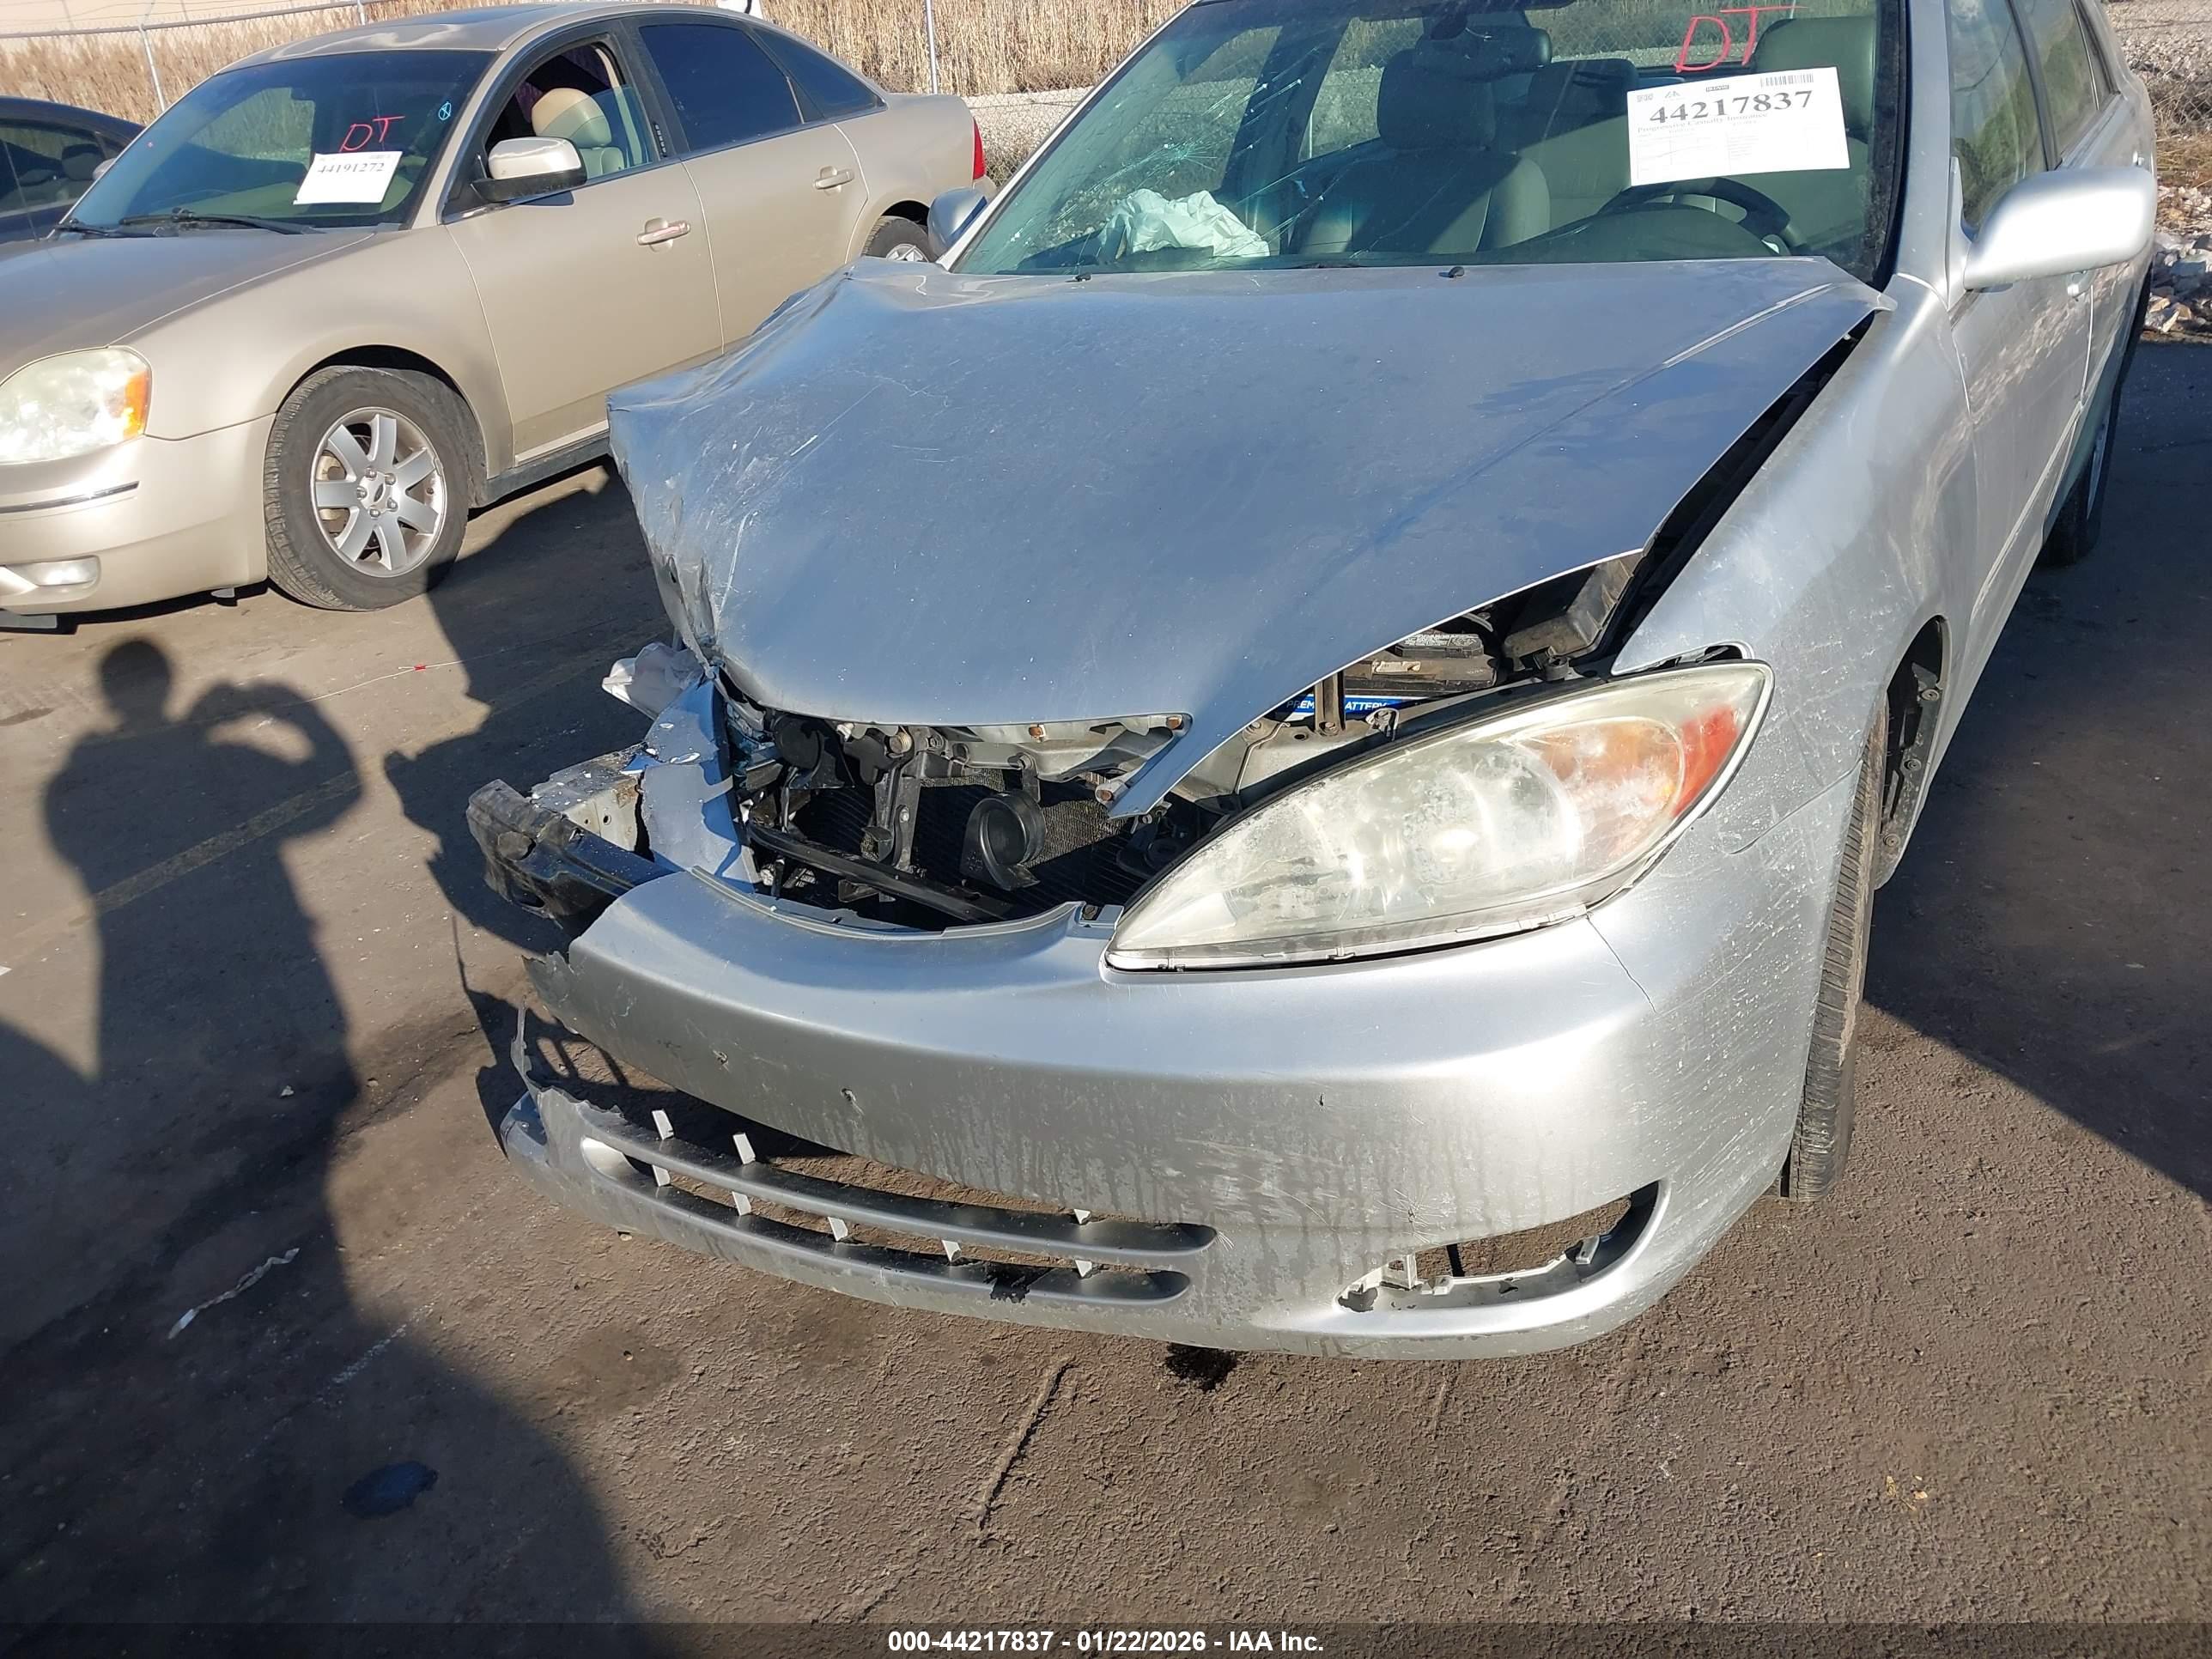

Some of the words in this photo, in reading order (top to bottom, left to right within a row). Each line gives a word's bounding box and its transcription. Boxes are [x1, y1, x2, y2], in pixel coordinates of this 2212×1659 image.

[1674, 6, 1809, 73] DT
[1650, 90, 1812, 124] 44217837
[339, 115, 405, 153] DT
[317, 162, 386, 173] 44191272
[1286, 700, 1315, 709] PREM
[1345, 701, 1387, 711] ATTERY
